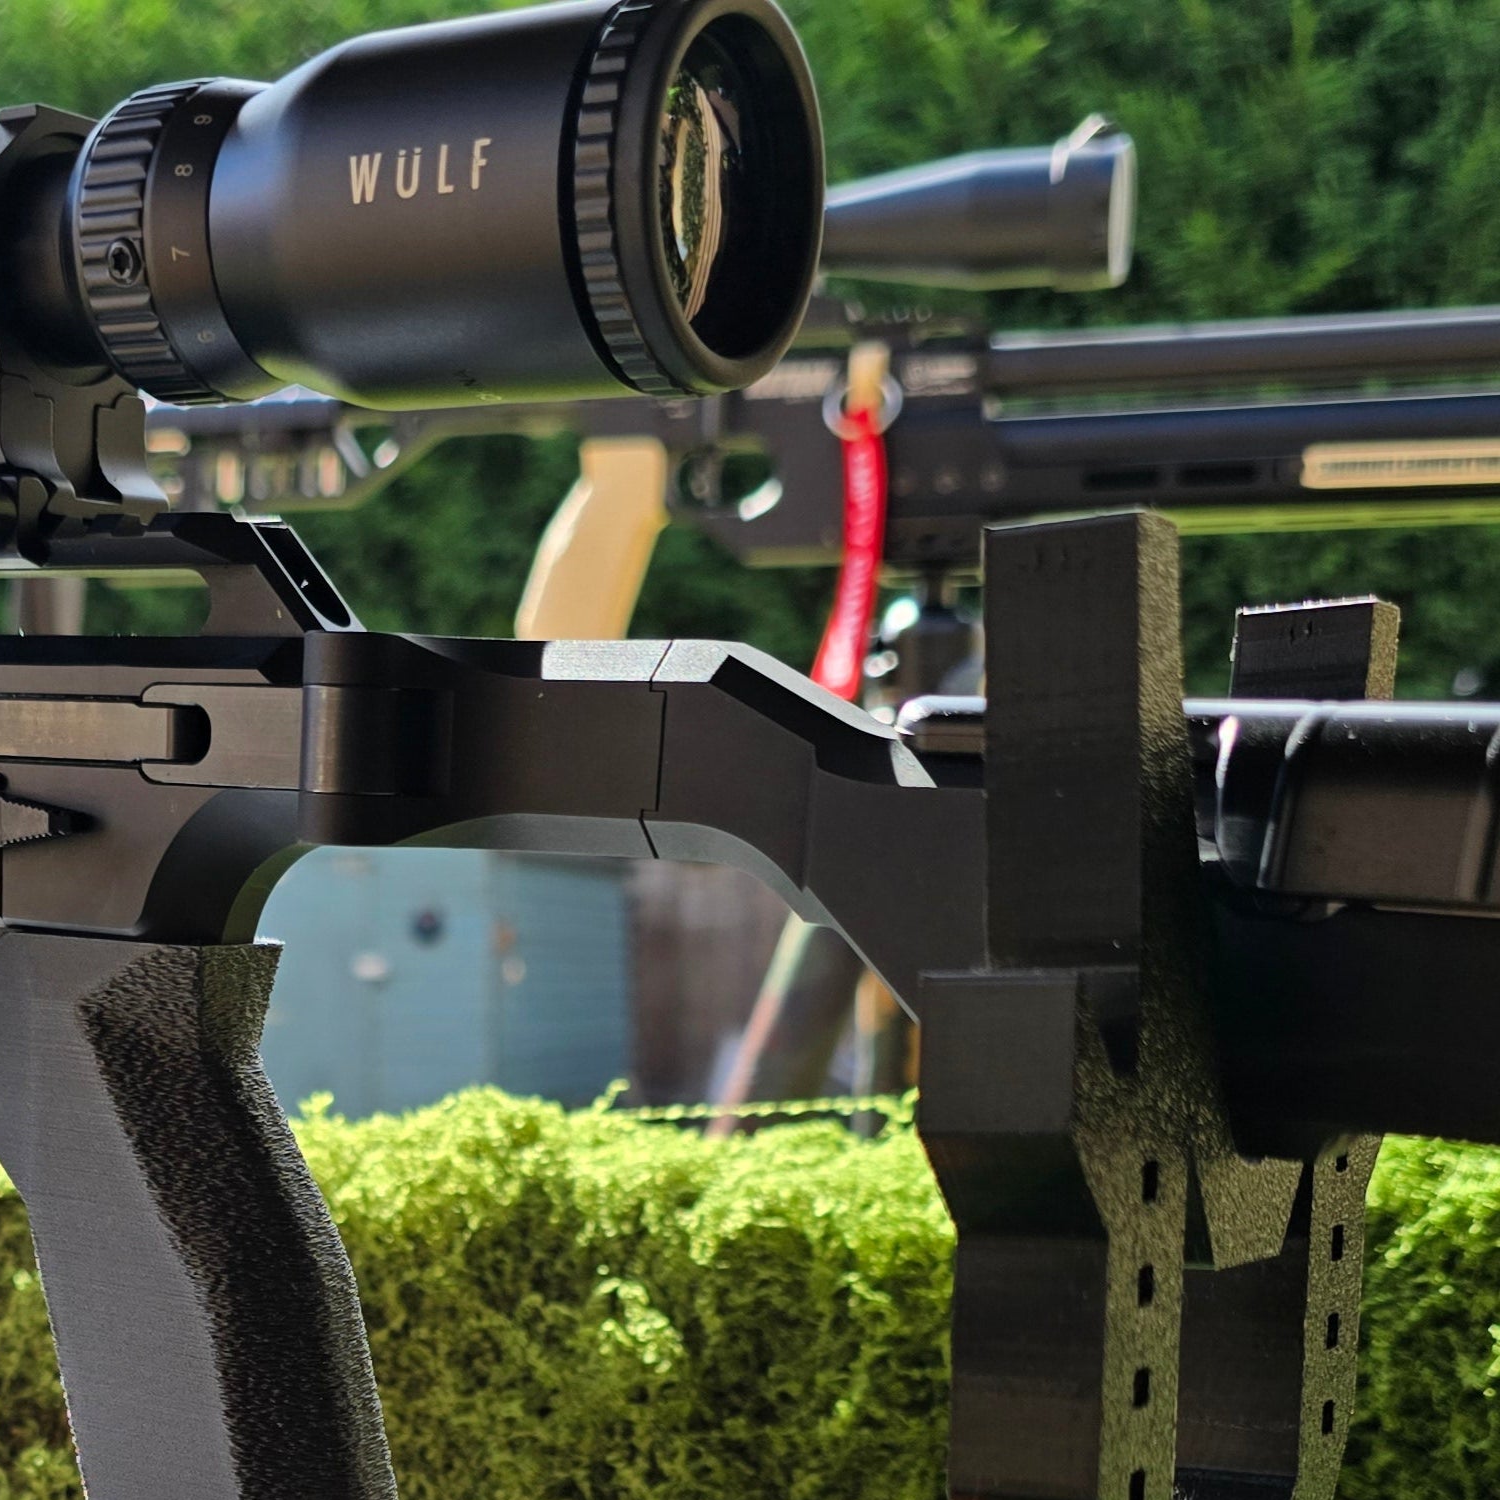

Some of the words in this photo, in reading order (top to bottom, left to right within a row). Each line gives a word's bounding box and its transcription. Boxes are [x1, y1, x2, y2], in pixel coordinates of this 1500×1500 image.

[194, 114, 213, 126] 9
[174, 163, 193, 177] 8
[350, 137, 492, 205] WÜLF
[171, 246, 191, 262] 7
